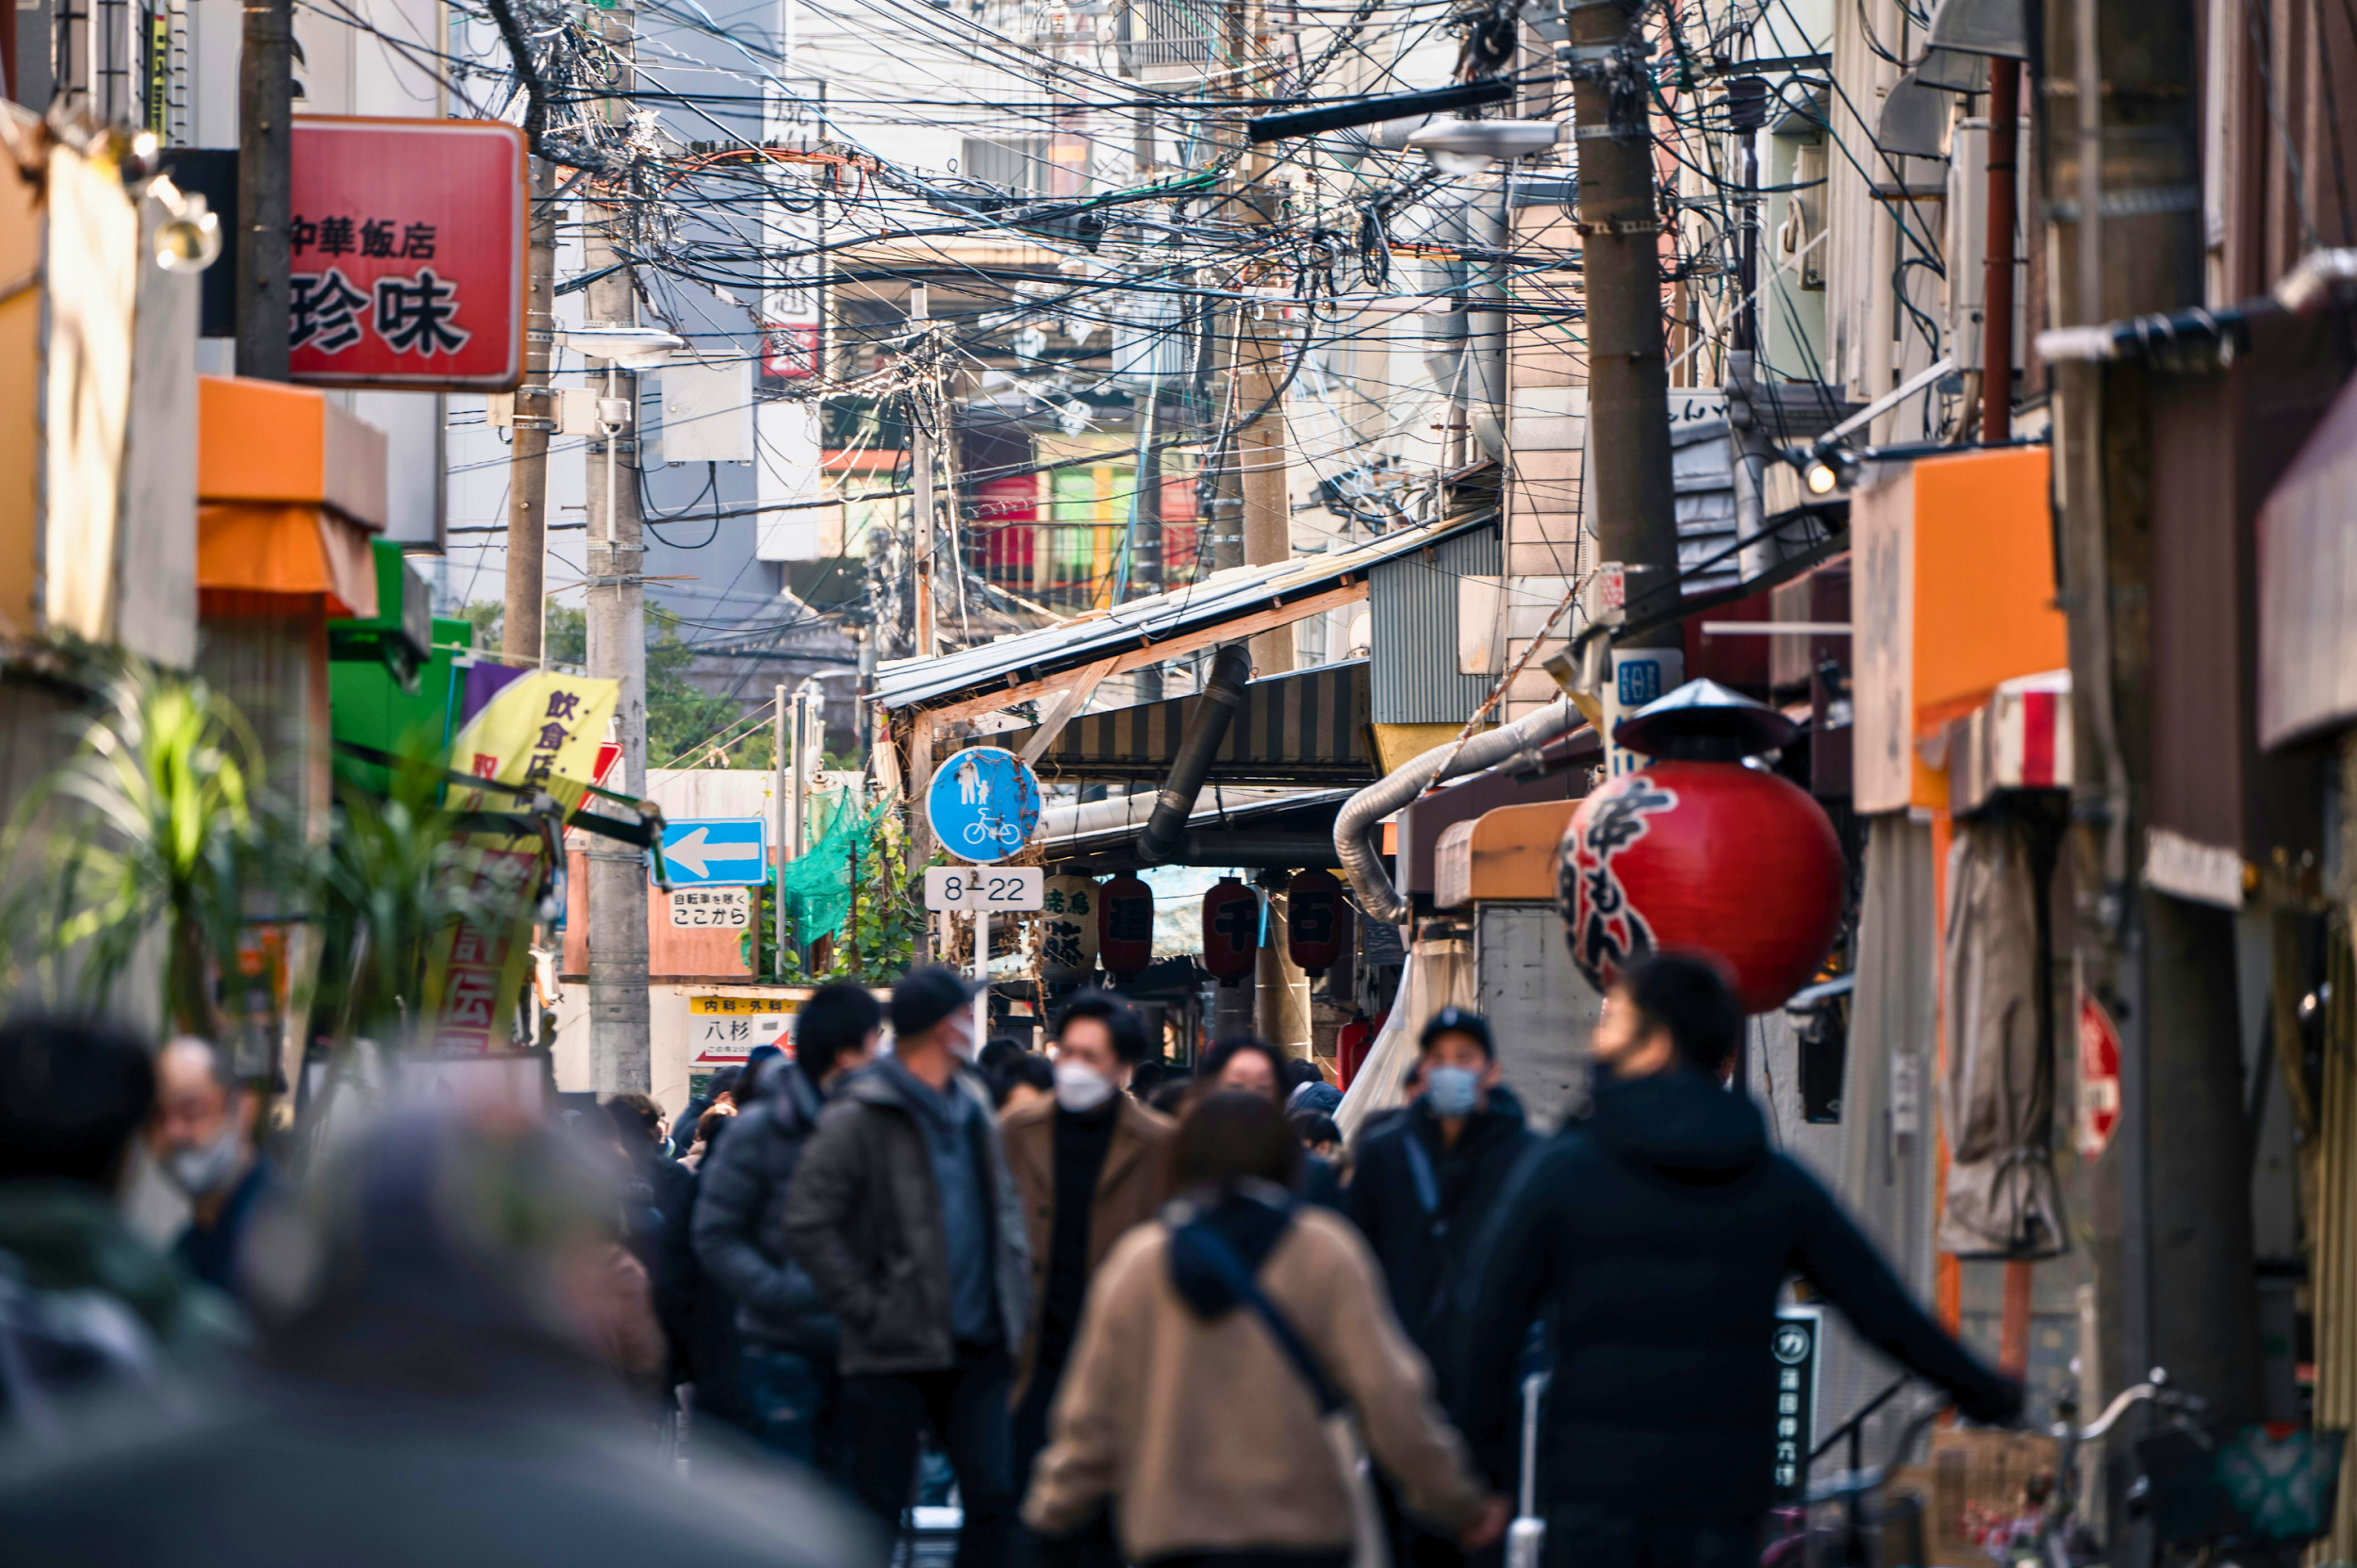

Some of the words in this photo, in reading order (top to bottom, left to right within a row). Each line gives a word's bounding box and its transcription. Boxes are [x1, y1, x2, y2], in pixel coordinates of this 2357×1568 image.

[290, 215, 437, 259] 中華飯店
[289, 268, 470, 357] 珍味
[945, 877, 1025, 900] 8-22
[674, 893, 745, 905] 自転車を除く
[674, 908, 746, 925] ここから
[704, 999, 801, 1013] 内科・外科・
